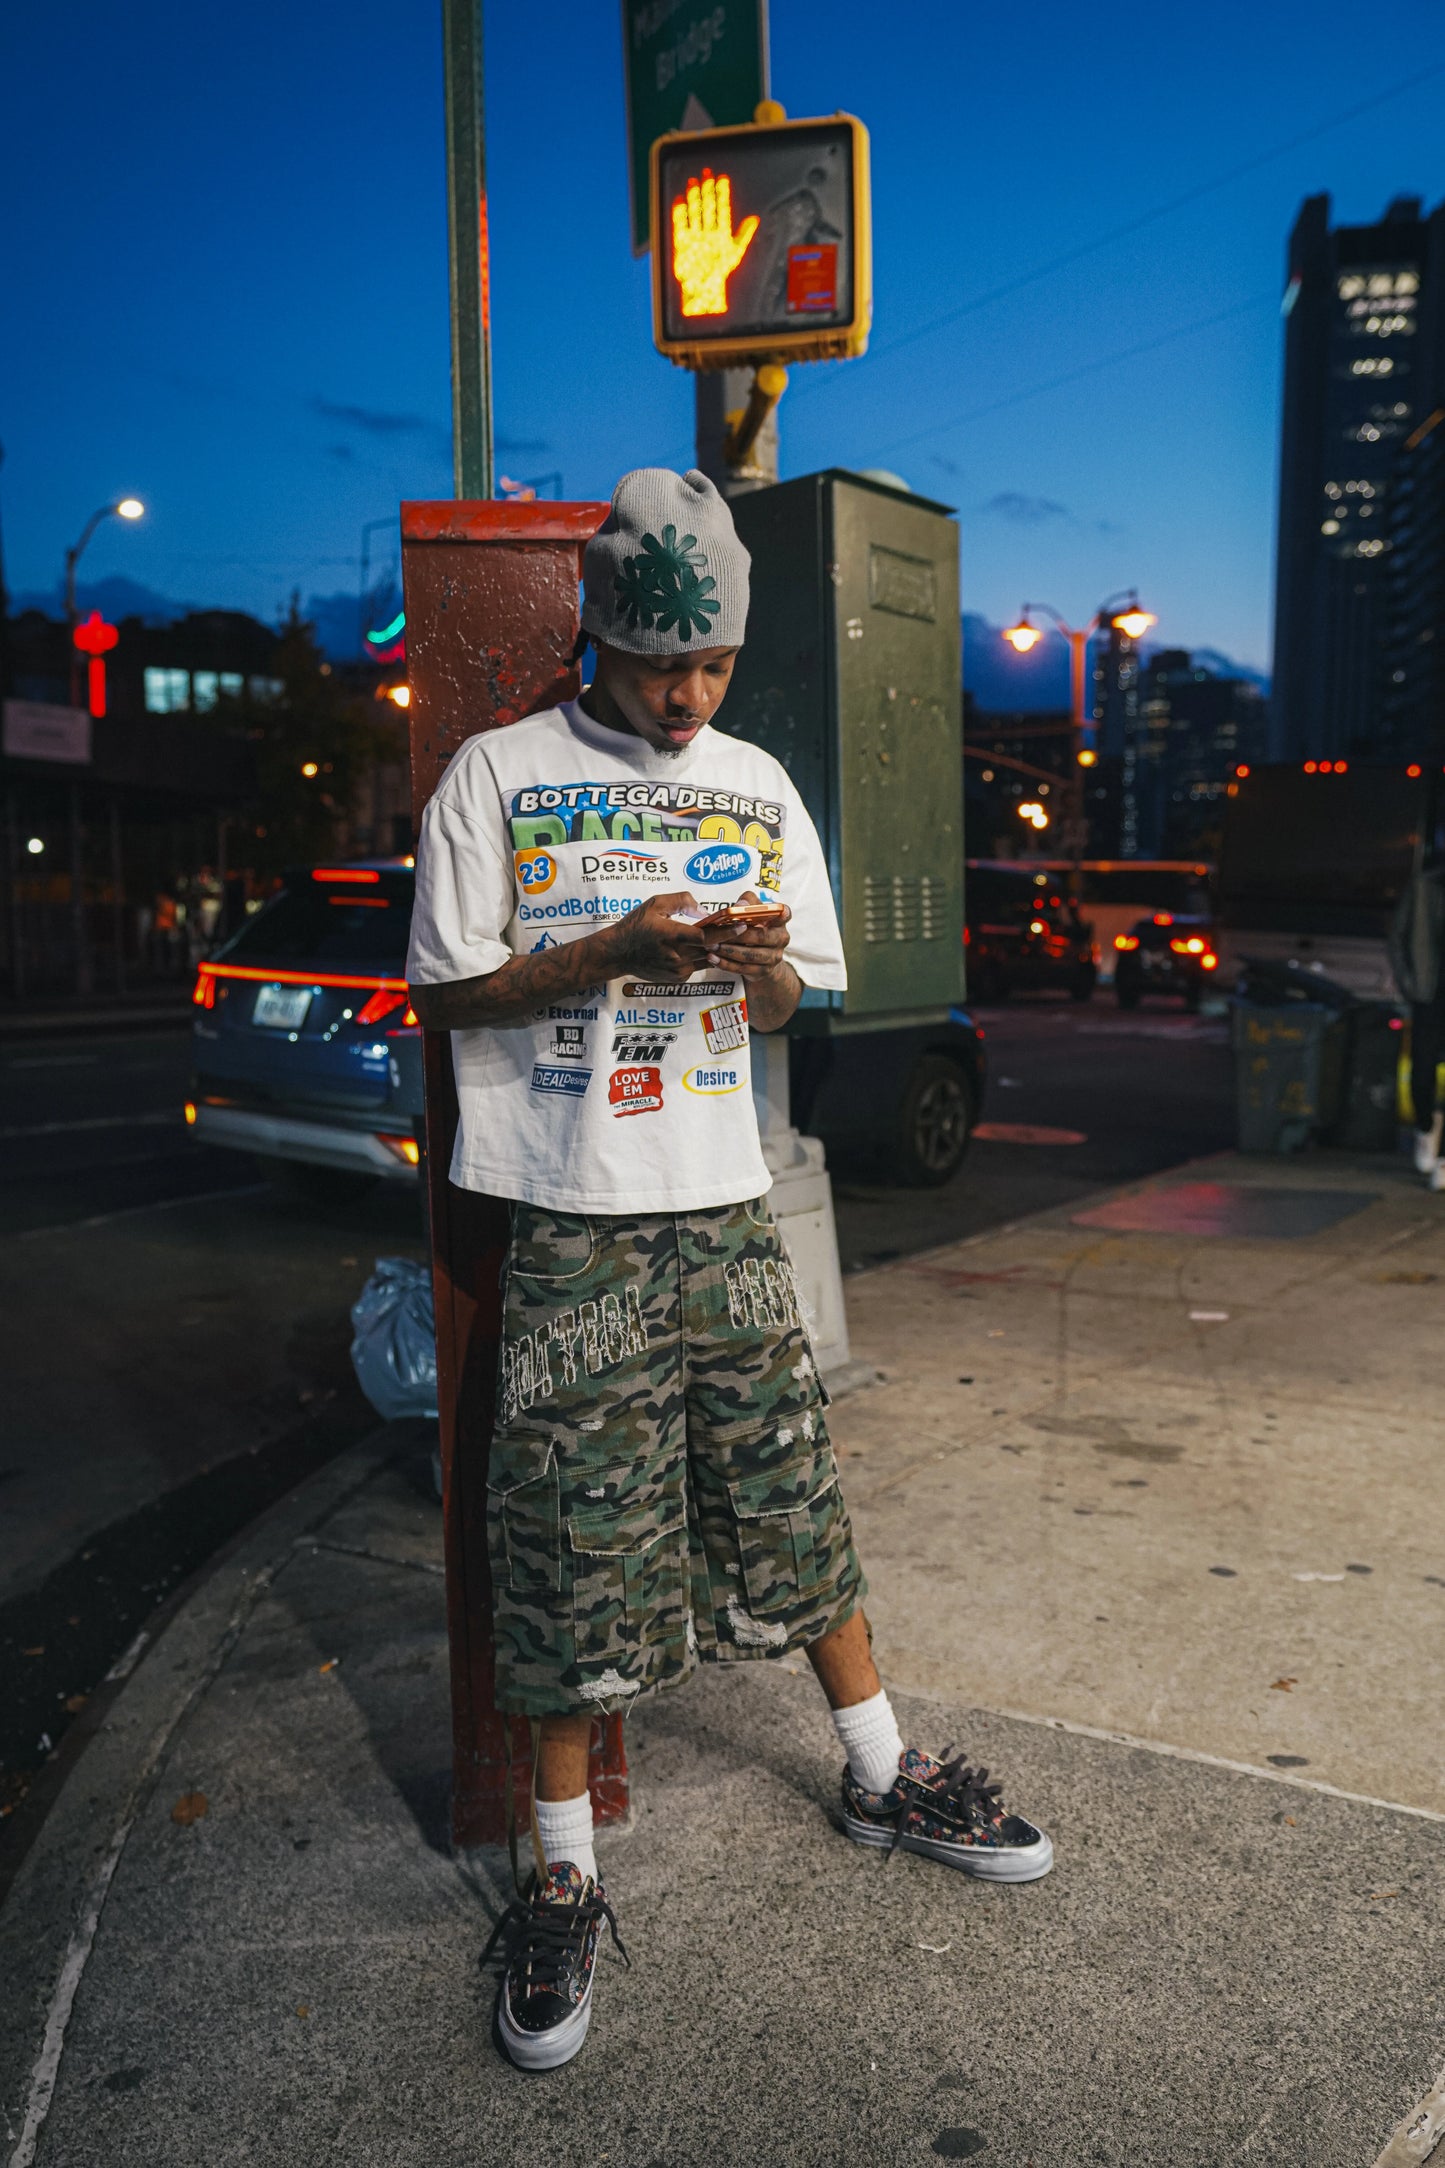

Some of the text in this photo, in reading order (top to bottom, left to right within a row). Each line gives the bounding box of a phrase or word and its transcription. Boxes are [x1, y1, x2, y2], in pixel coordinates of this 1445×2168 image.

[519, 784, 781, 826] BOTTEGA DESIRES
[519, 856, 551, 885] 23
[581, 856, 668, 875] Desires
[693, 852, 746, 880] Bottega
[581, 872, 671, 884] The Better Life Experts
[633, 983, 733, 996] SmartDesires
[548, 1006, 599, 1021] Eternal
[614, 1009, 685, 1025] All-Star
[710, 1002, 744, 1031] RUFF
[563, 1028, 580, 1041] BD
[551, 1041, 587, 1056] RACING
[617, 1045, 667, 1062] EM
[615, 1072, 650, 1086] LOVE
[696, 1069, 737, 1087] Desire
[623, 1084, 643, 1096] EM
[621, 1097, 652, 1108] MIRACLE
